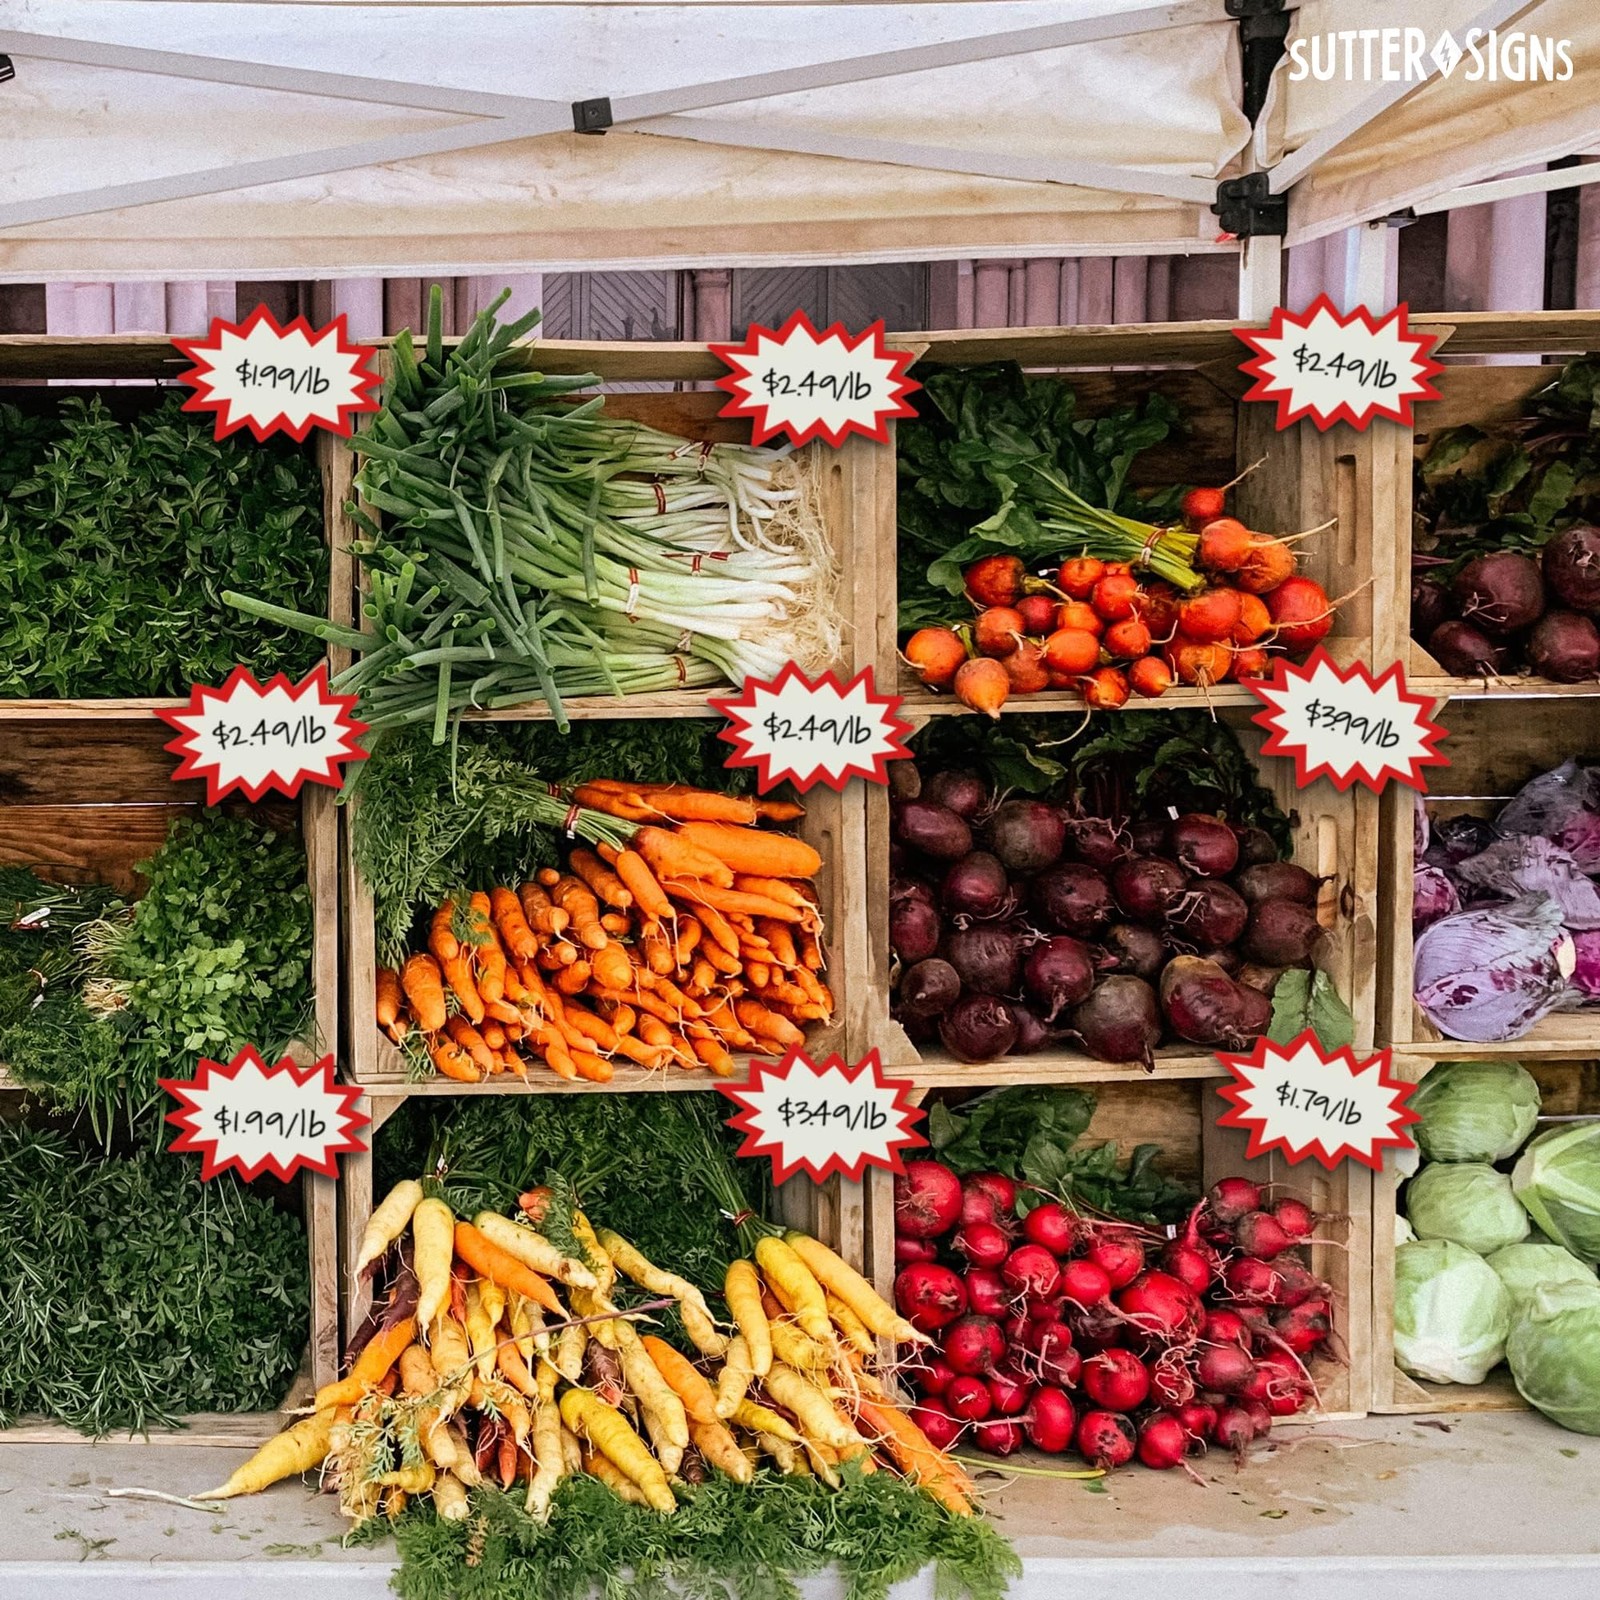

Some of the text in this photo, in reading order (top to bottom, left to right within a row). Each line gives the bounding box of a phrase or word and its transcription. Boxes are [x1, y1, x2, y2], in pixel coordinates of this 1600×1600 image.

[236, 359, 330, 395] $1.99/lb
[762, 367, 872, 402] $2.49/lb
[1293, 344, 1396, 390] $2.49/lb
[212, 715, 327, 750] $2.49/lb
[764, 711, 872, 746] $2.49/lb
[1276, 1080, 1362, 1125] $1.79/lb
[213, 1105, 326, 1139] $1.99/lb
